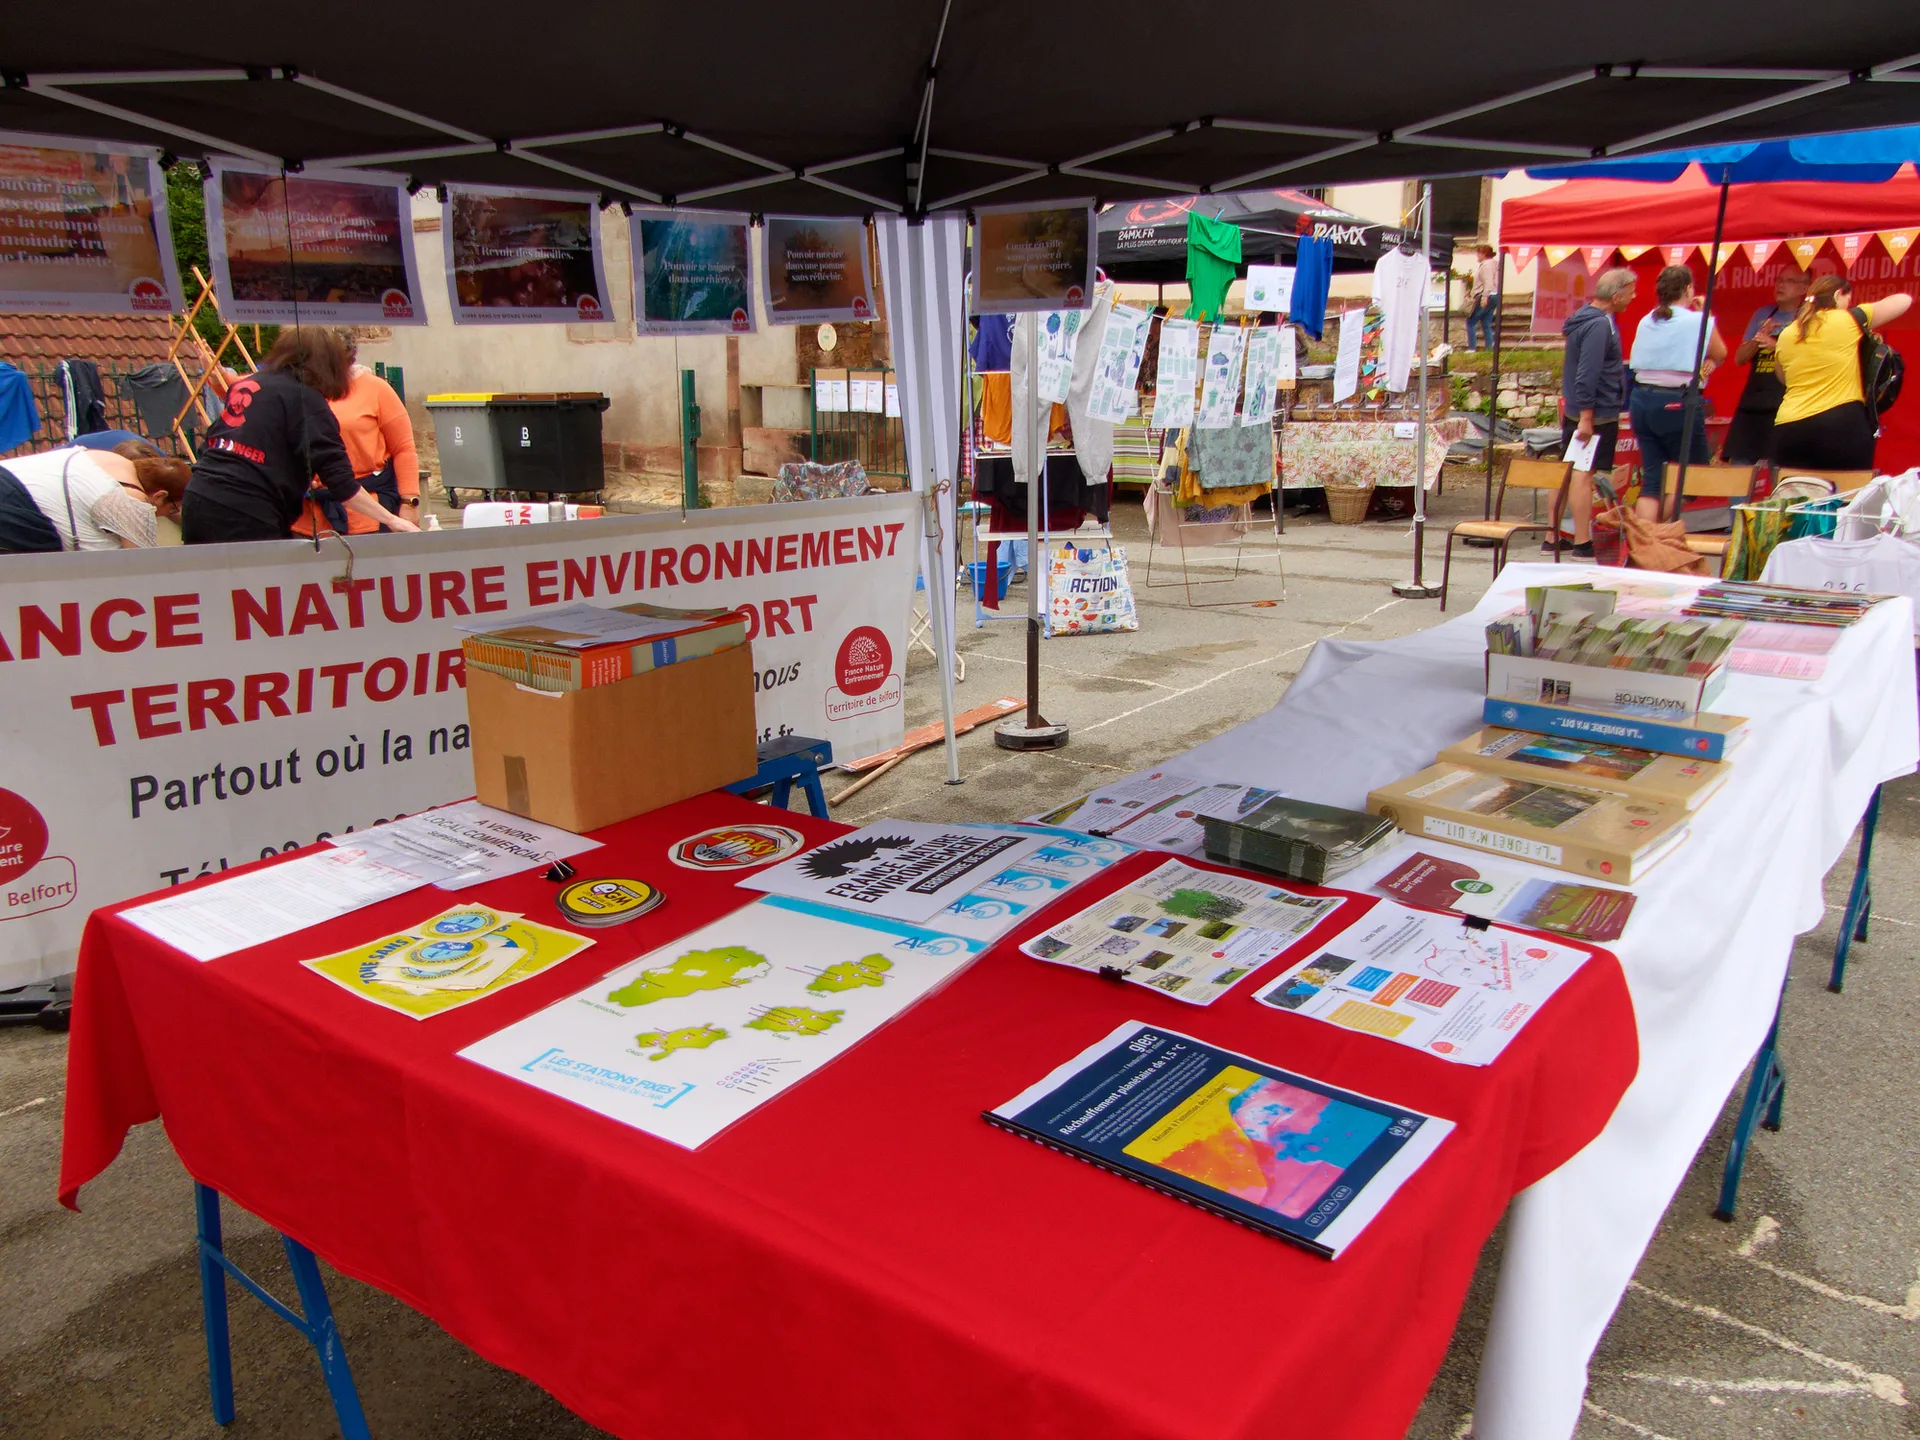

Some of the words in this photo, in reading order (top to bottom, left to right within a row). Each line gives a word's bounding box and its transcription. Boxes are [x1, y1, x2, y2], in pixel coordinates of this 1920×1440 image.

[19, 215, 35, 228] la
[38, 217, 145, 236] composition
[1117, 228, 1155, 241] 24MX.FR
[335, 231, 389, 243] pollution
[786, 250, 816, 260] Pouvoir
[663, 260, 698, 272] Pouvoir
[705, 273, 732, 285] rivière.
[791, 274, 810, 282] sans
[455, 427, 462, 439] B
[521, 427, 530, 440] B
[231, 566, 508, 641] NATURE
[526, 522, 904, 607] ENVIRONNEMENT
[1070, 576, 1118, 593] ACTION
[844, 667, 864, 677] France
[865, 663, 884, 672] Nature
[844, 671, 884, 685] Environnement
[828, 699, 864, 714] Territoire
[866, 696, 876, 706] de
[879, 690, 899, 702] Belfort
[1614, 691, 1686, 712] NAVIGATOR
[130, 747, 301, 819] Partout
[315, 735, 366, 777] où
[382, 729, 413, 765] la
[422, 814, 464, 834] LOCAL
[461, 826, 542, 863] COMMERCIAL
[486, 821, 542, 844] VENDRE
[712, 829, 785, 855] Linky
[825, 858, 901, 898] FRANCE
[899, 832, 968, 869] NATURE
[849, 835, 993, 904] ENVIRONNEMENT
[917, 860, 968, 893] TERRITOIRE
[968, 852, 981, 868] DE
[7, 881, 73, 907] Belfort
[375, 937, 408, 961] SANS
[1128, 1034, 1159, 1053] giec
[548, 1055, 573, 1072] LES
[569, 1058, 638, 1089] STATIONS
[636, 1078, 677, 1096] FIXES
[1059, 1092, 1122, 1135] Réchauffement
[1118, 1065, 1156, 1096] planétaire
[1152, 1059, 1166, 1072] de
[1161, 1048, 1177, 1065] 1,5
